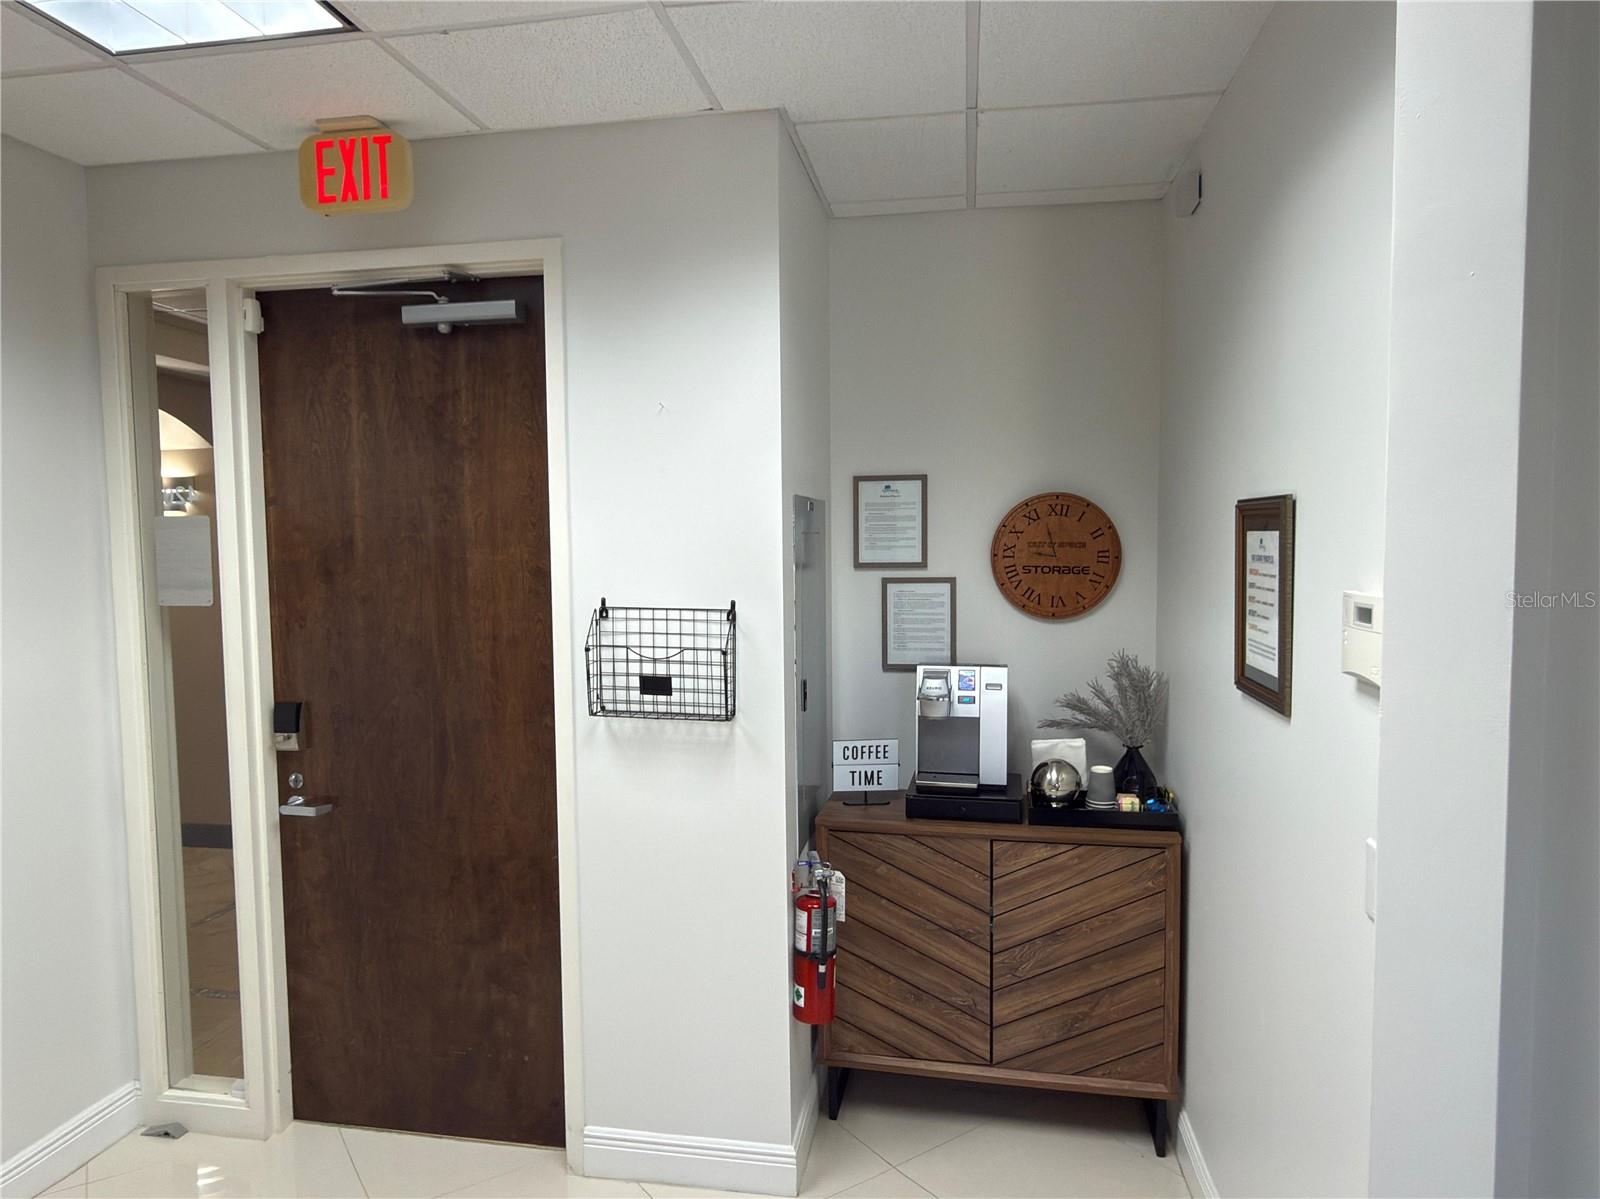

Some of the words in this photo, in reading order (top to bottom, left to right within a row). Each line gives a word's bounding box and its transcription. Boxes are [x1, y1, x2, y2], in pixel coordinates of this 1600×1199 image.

[314, 134, 392, 204] EXIT
[1023, 508, 1041, 526] XI
[1047, 503, 1071, 517] XII
[1009, 524, 1024, 539] X
[1089, 527, 1105, 540] II
[1096, 550, 1111, 565] III
[1021, 565, 1091, 575] STORAGE
[842, 745, 889, 761] COFFEE
[849, 770, 883, 786] TIME
